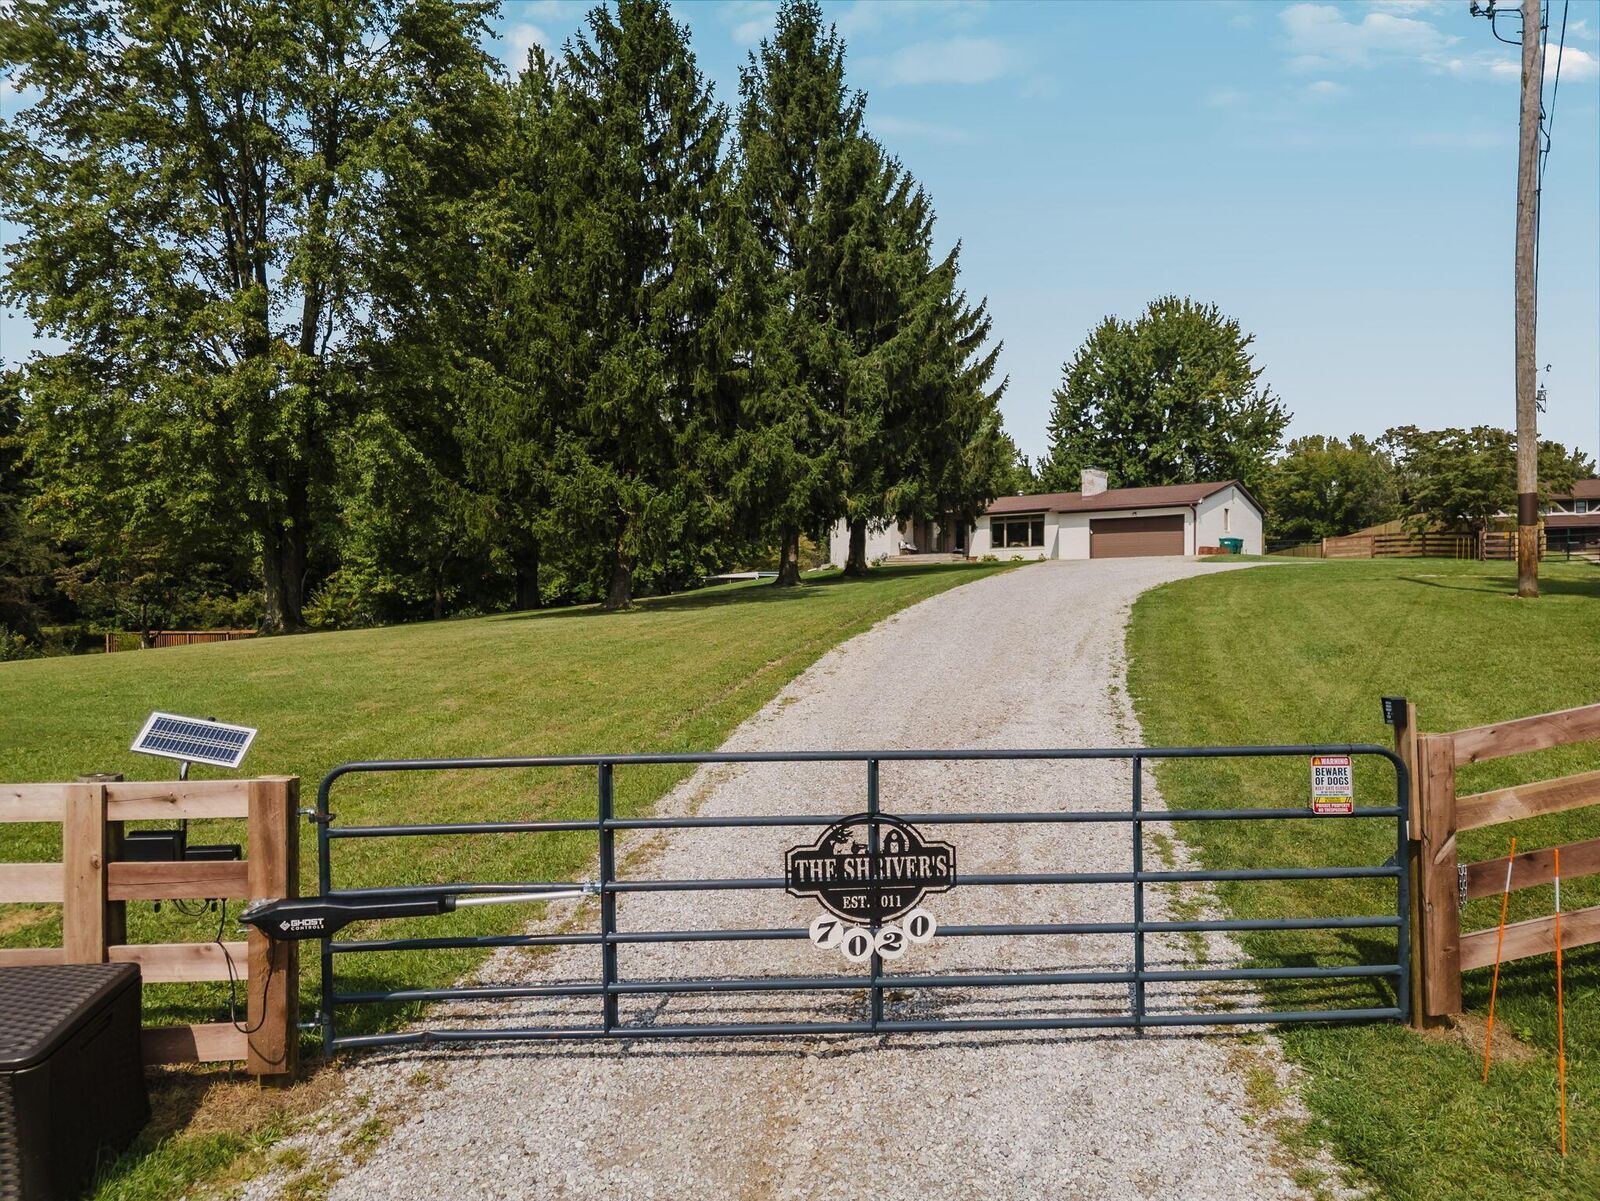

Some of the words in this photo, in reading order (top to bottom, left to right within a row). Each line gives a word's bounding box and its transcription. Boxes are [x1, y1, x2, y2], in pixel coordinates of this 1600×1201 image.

[1321, 757, 1349, 766] WARNING
[1315, 767, 1348, 777] BEWARE
[1315, 776, 1325, 786] OF
[1327, 776, 1349, 786] DOGS
[795, 858, 837, 882] THE
[843, 895, 870, 909] EST.
[876, 895, 902, 908] 011
[290, 918, 324, 927] GHOST
